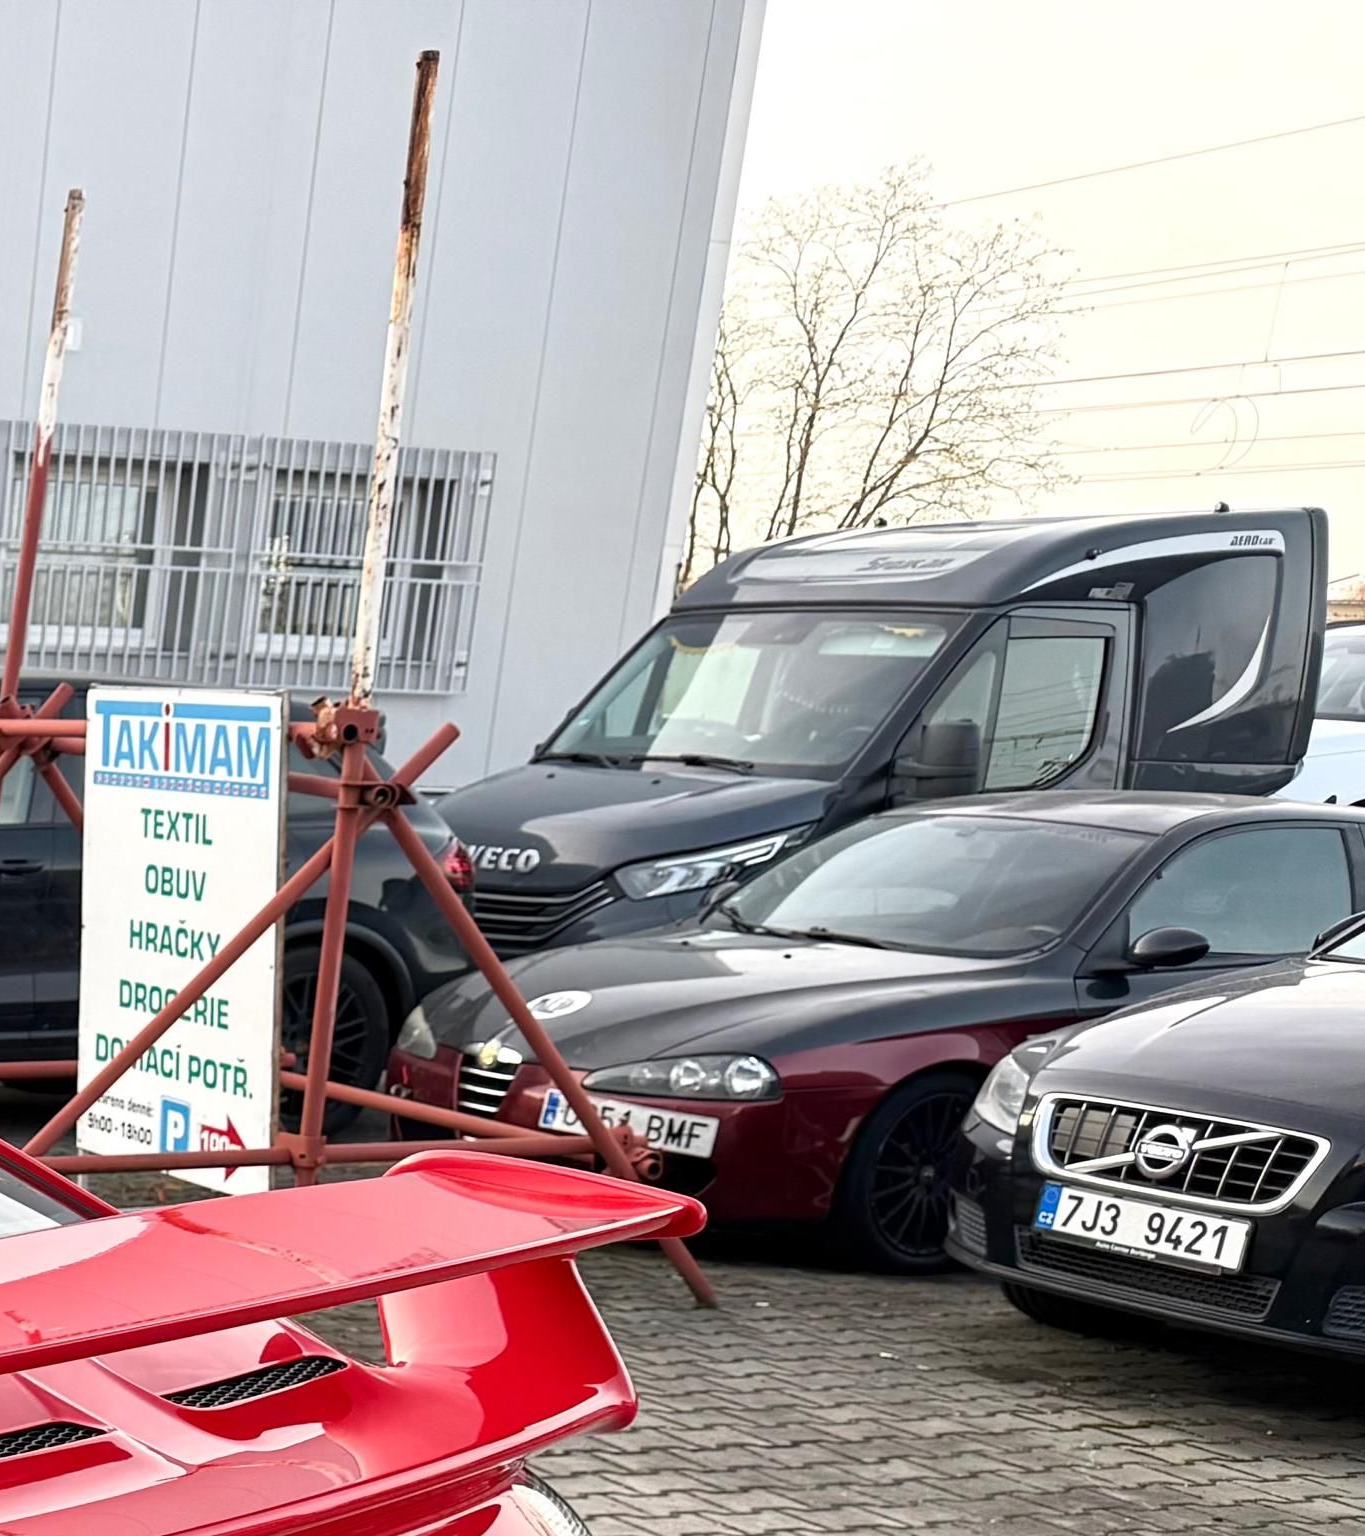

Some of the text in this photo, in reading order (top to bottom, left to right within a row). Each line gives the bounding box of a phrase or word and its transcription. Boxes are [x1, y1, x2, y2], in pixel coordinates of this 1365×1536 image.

[141, 807, 213, 846] TEXTIL
[468, 845, 540, 873] VECO
[145, 863, 207, 901] OBUV
[129, 919, 221, 962] HRAČKY
[119, 978, 229, 1030] DRORIE
[187, 1055, 254, 1100] POTŘ.
[87, 1112, 113, 1133] 9h00
[166, 1109, 186, 1151] P
[200, 1129, 242, 1152] 100
[644, 1113, 710, 1150] BMF
[1038, 1211, 1054, 1225] CZ
[1061, 1194, 1121, 1236] 7J3
[1144, 1212, 1229, 1260] 9421
